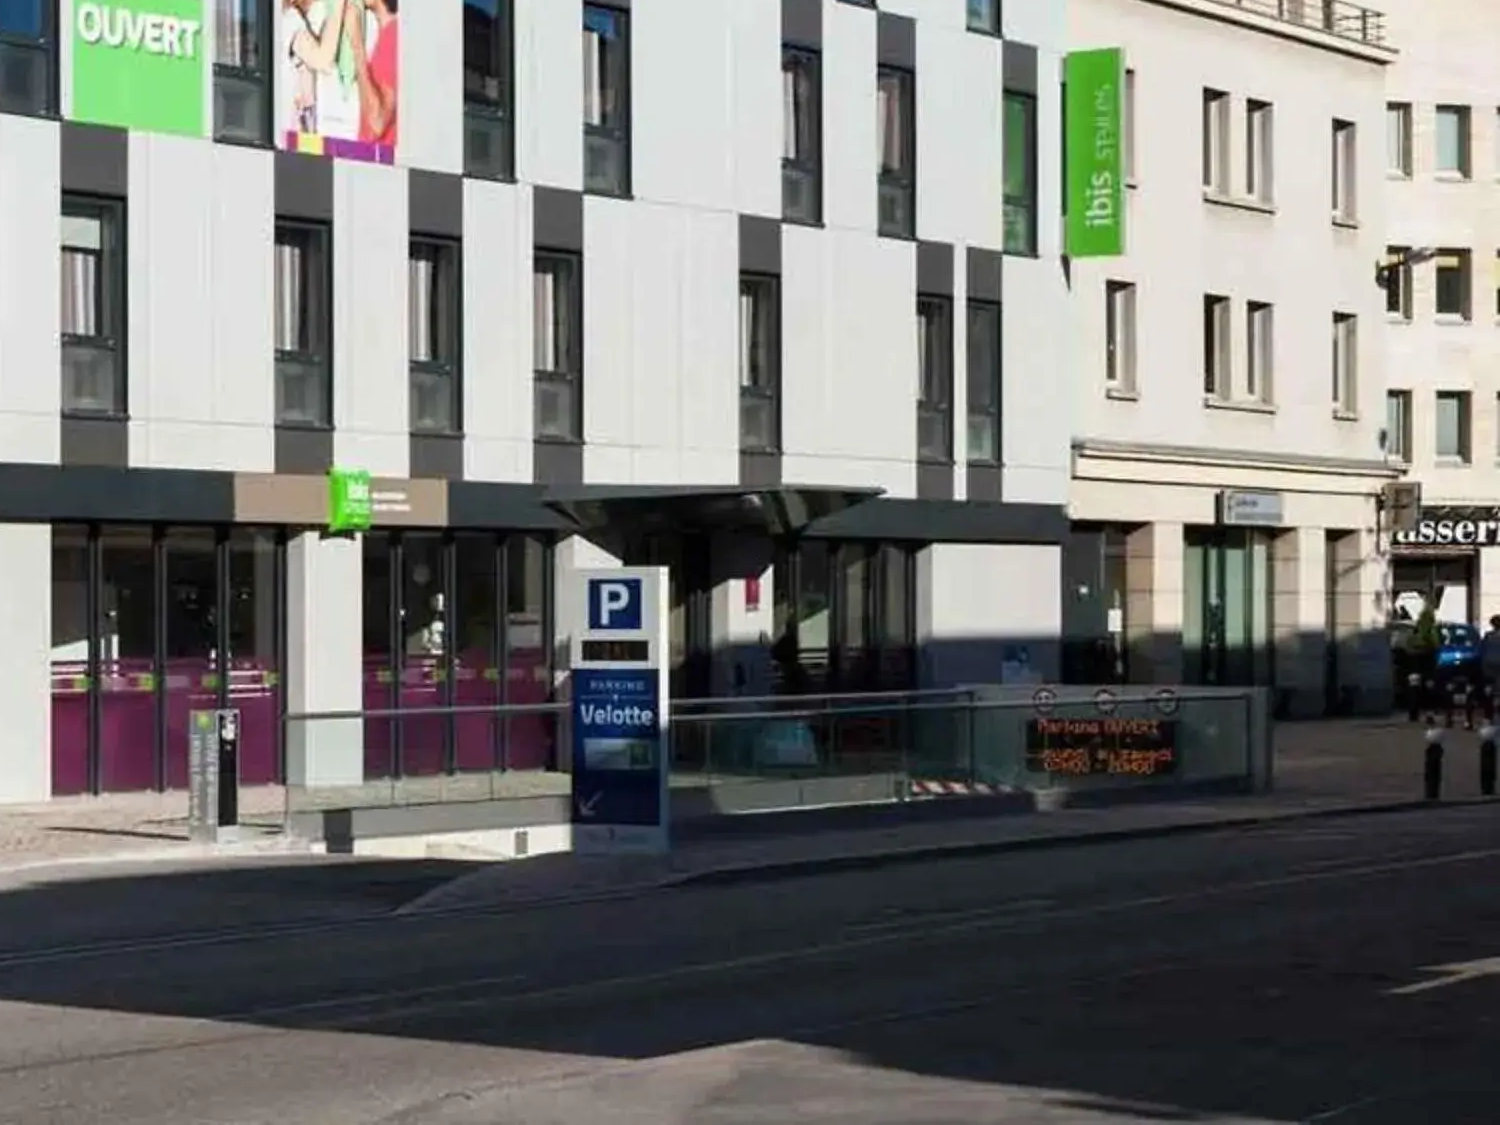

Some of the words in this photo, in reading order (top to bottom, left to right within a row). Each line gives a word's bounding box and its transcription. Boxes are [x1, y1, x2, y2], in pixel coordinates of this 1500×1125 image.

[78, 4, 199, 57] OUVERT
[1085, 171, 1113, 227] ibis
[600, 584, 629, 625] P
[580, 704, 653, 725] Velotte
